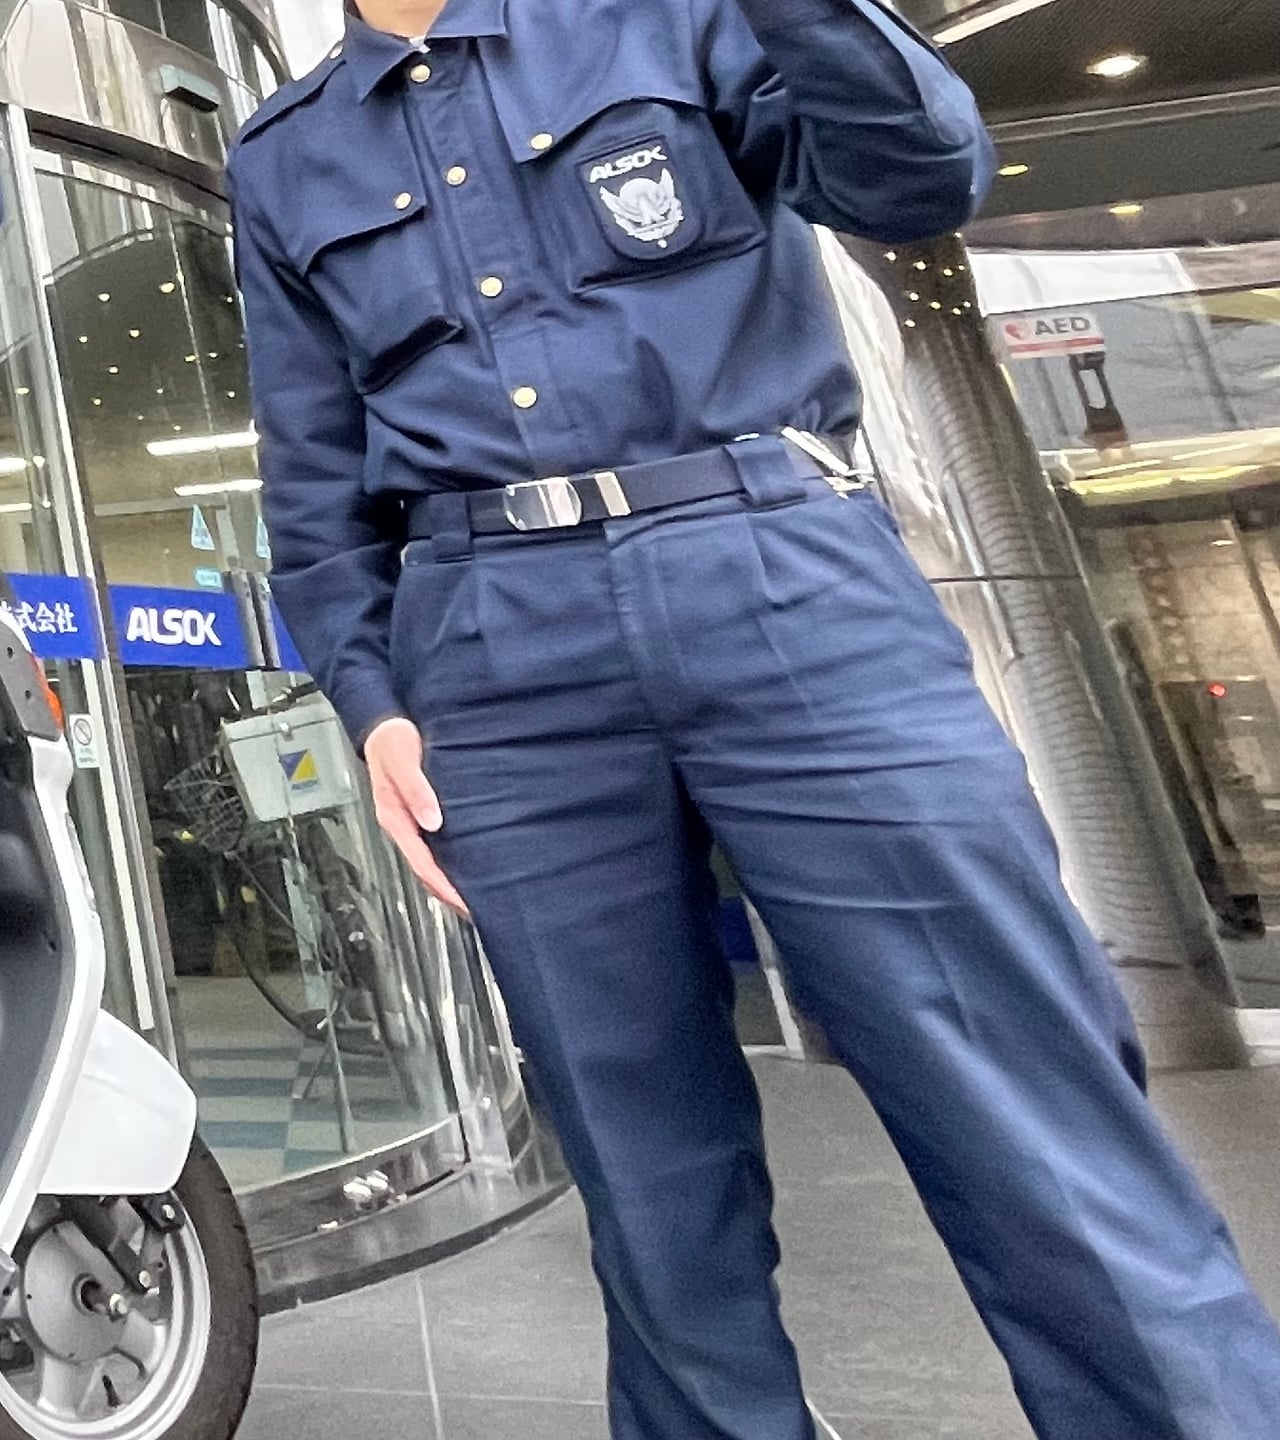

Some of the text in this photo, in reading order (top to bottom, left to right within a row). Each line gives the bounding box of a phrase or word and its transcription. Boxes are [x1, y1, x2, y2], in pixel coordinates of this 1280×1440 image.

[589, 145, 668, 183] ALSOK
[1034, 316, 1092, 336] AED
[126, 605, 223, 647] ALSOK
